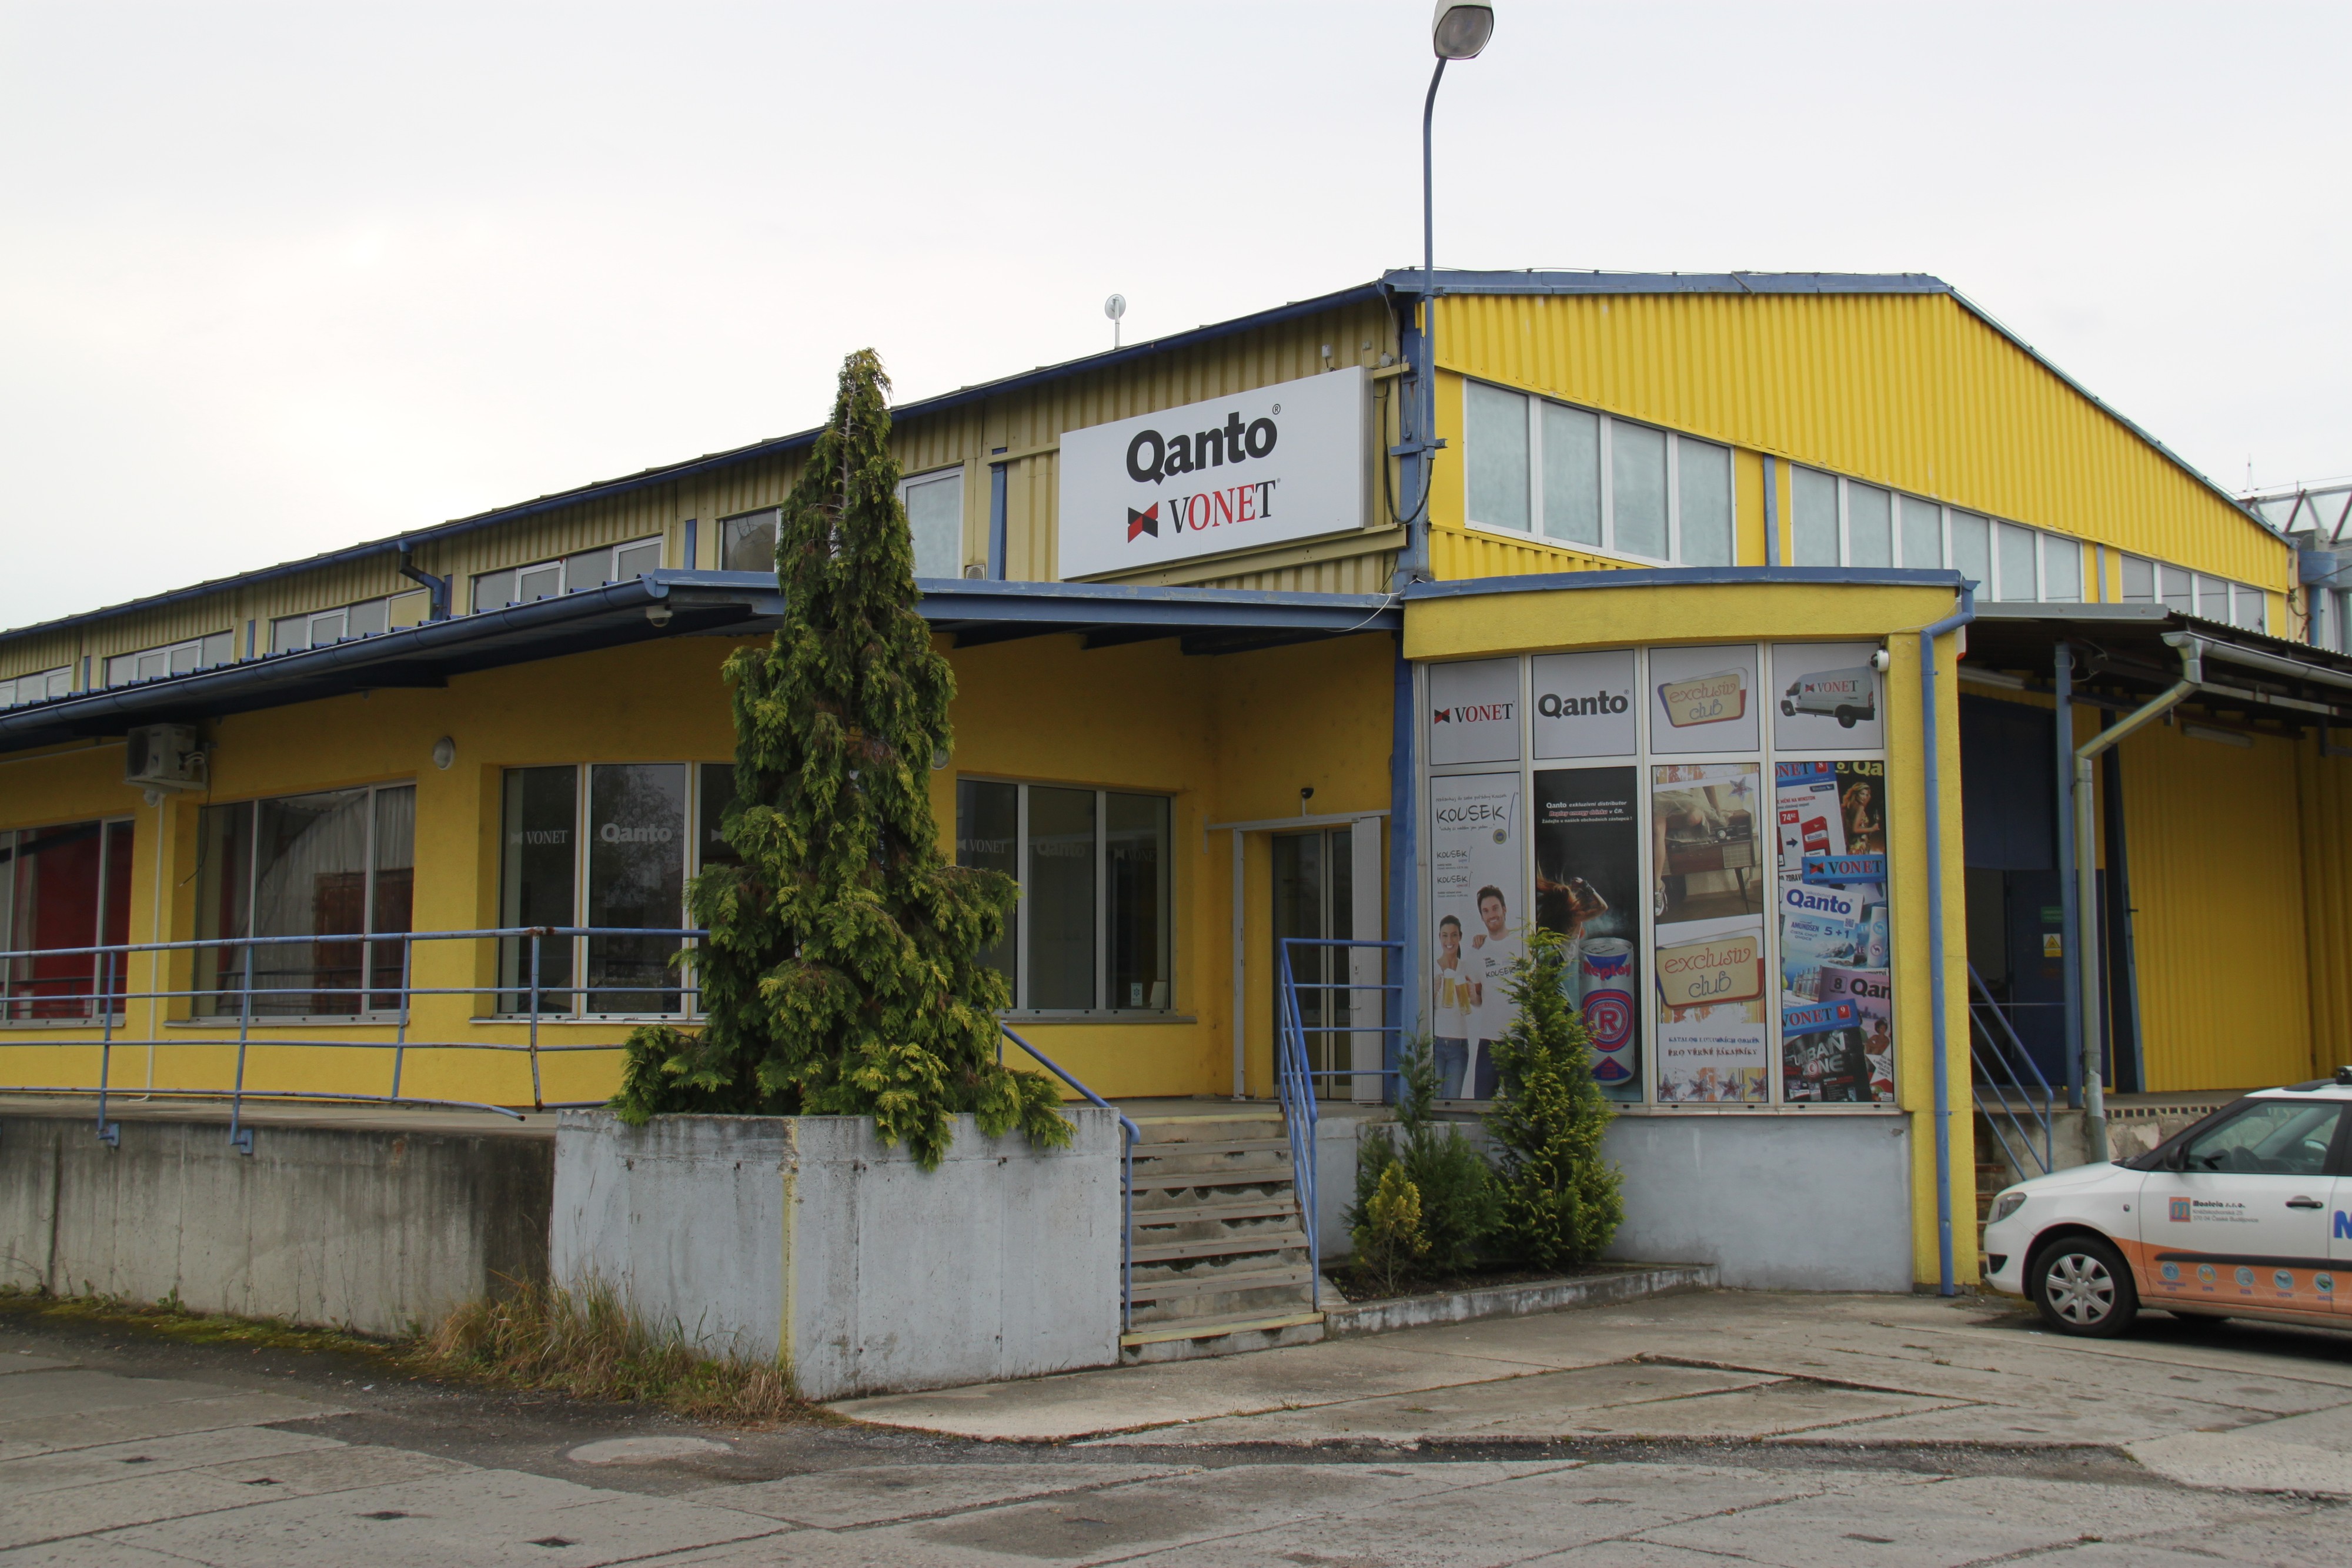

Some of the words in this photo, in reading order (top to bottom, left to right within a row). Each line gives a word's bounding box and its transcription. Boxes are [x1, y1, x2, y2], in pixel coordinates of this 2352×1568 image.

[1168, 480, 1277, 533] VONET
[1669, 682, 1737, 704] exclusiv
[1818, 680, 1858, 693] VONET
[1455, 703, 1513, 723] VONET
[1689, 699, 1723, 720] club
[1436, 804, 1506, 824] KOUSEK
[526, 830, 568, 844] VONET
[600, 823, 672, 844] Qanto
[969, 838, 1006, 854] VONET
[1436, 850, 1468, 859] KOUSEK
[1828, 860, 1882, 874] VONET
[1437, 875, 1468, 884] KOUSEK
[1791, 921, 1819, 932] AMUNDSEN
[1824, 927, 1833, 935] 5
[1845, 930, 1849, 939] 1
[1665, 947, 1751, 974] exclusiv
[1688, 971, 1732, 998] club
[1834, 978, 1842, 989] 8
[1598, 1009, 1619, 1033] R
[1668, 1048, 1685, 1057] PRO
